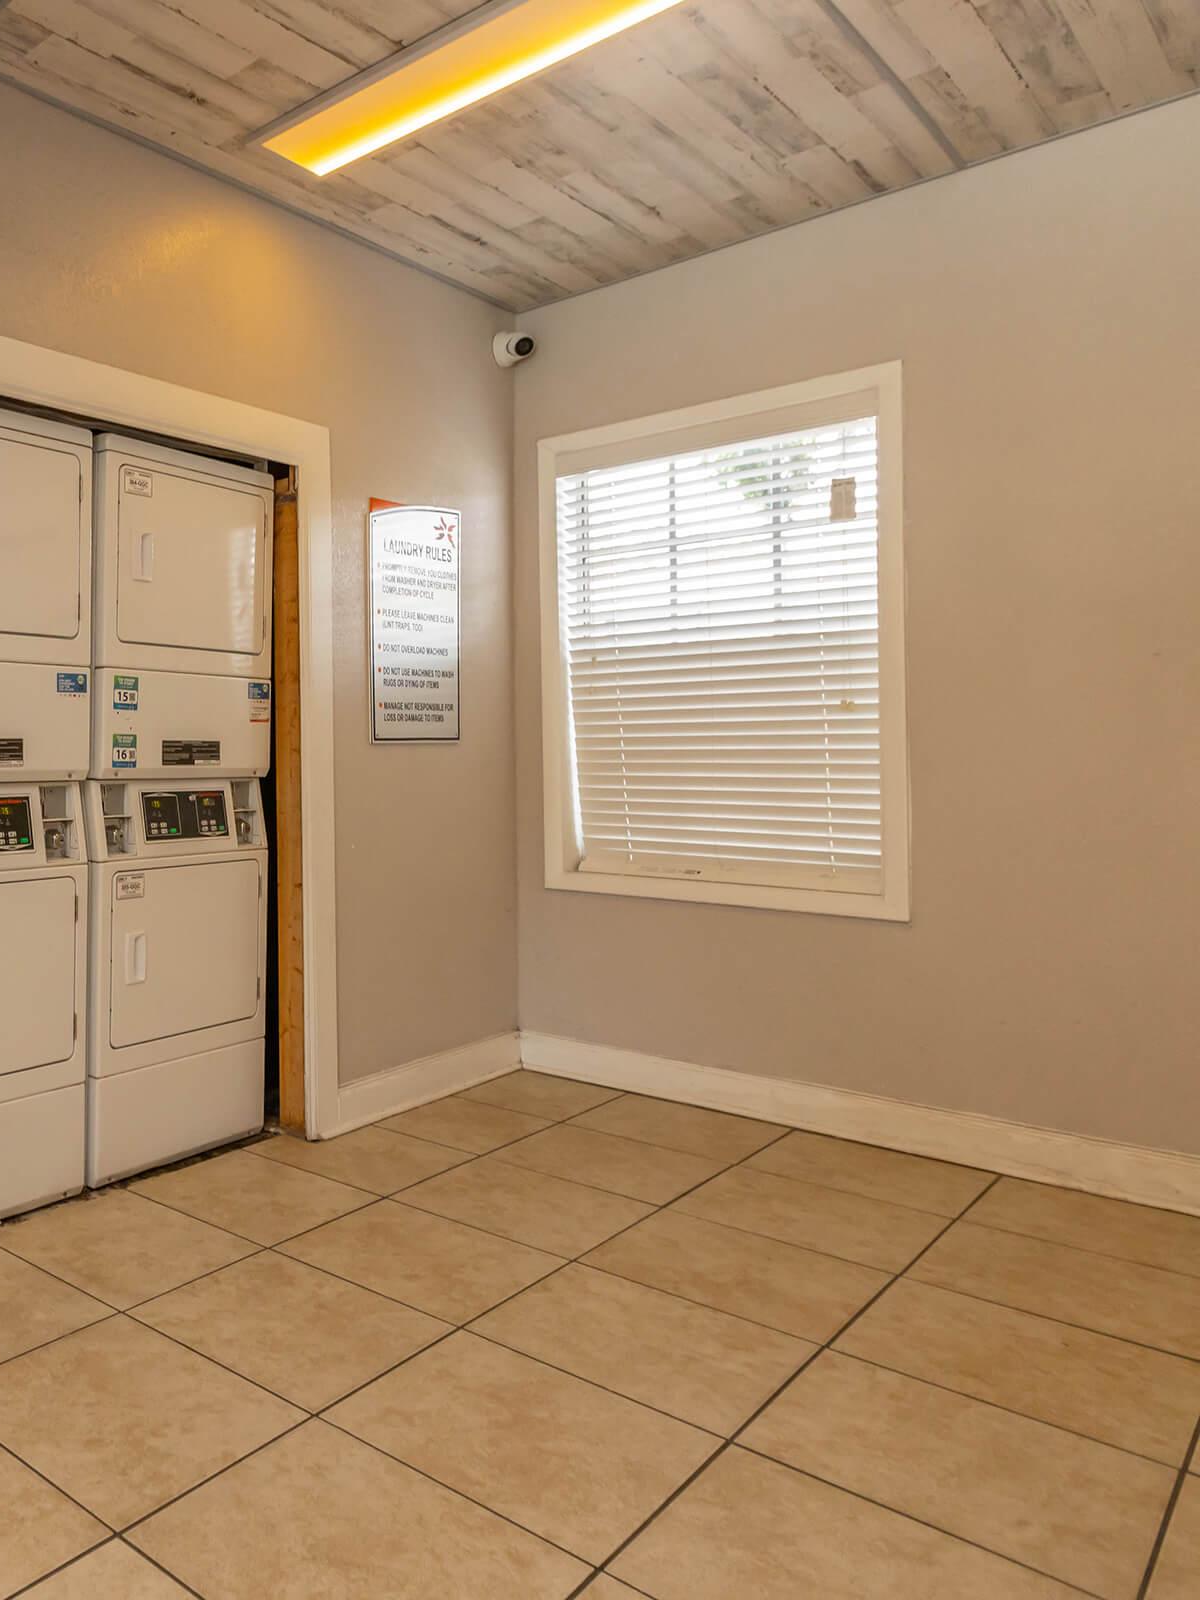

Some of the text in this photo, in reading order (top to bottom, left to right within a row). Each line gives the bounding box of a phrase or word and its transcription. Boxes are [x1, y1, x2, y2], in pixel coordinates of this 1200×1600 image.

[384, 538, 452, 563] LAUNDRY RULES
[397, 576, 416, 586] WASHER
[417, 578, 426, 588] AND
[427, 580, 442, 590] DRYER
[443, 582, 457, 592] AFTER
[382, 584, 434, 600] COMPLETION OF CYCLE
[382, 608, 455, 624] PLEASE LEAVE MACHINES CLEAN
[383, 643, 448, 657] DO NOT OVERLOAD MACHINES
[383, 666, 454, 679] DO NOT USE MACHINES TO WASH
[383, 678, 439, 689] RUGS OR DYING OF ITEMS
[118, 691, 128, 701] 15
[384, 702, 454, 712] MANAGE NOT RESPONSIBLE FOR
[384, 713, 444, 722] LOSS OR DAMAGE TO ITEMS
[116, 750, 127, 760] 16
